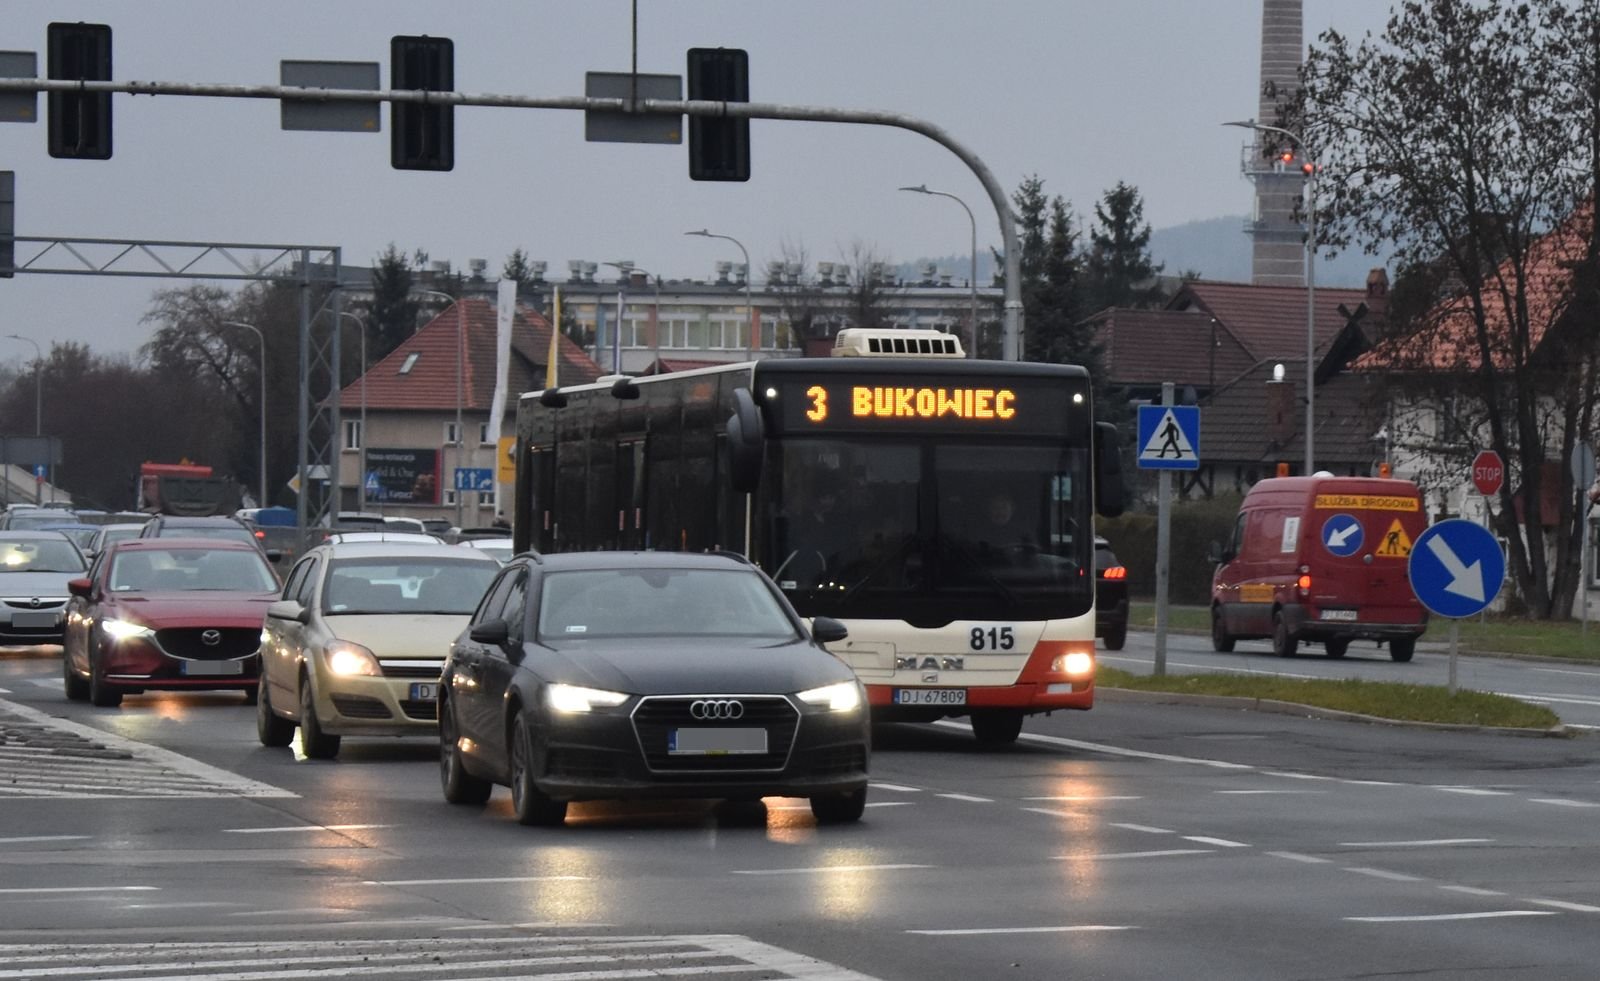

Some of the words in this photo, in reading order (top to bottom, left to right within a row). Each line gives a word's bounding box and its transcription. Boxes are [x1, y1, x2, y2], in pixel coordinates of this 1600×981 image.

[806, 386, 827, 421] 3
[852, 386, 1016, 418] BUKOWIEC
[1475, 466, 1501, 480] STOP
[1317, 495, 1358, 506] SŁUŻBA
[1361, 497, 1415, 508] DROGOWA
[970, 627, 1014, 651] 815
[896, 656, 964, 670] MAN
[902, 690, 919, 703] DJ
[924, 690, 964, 703] 67809
